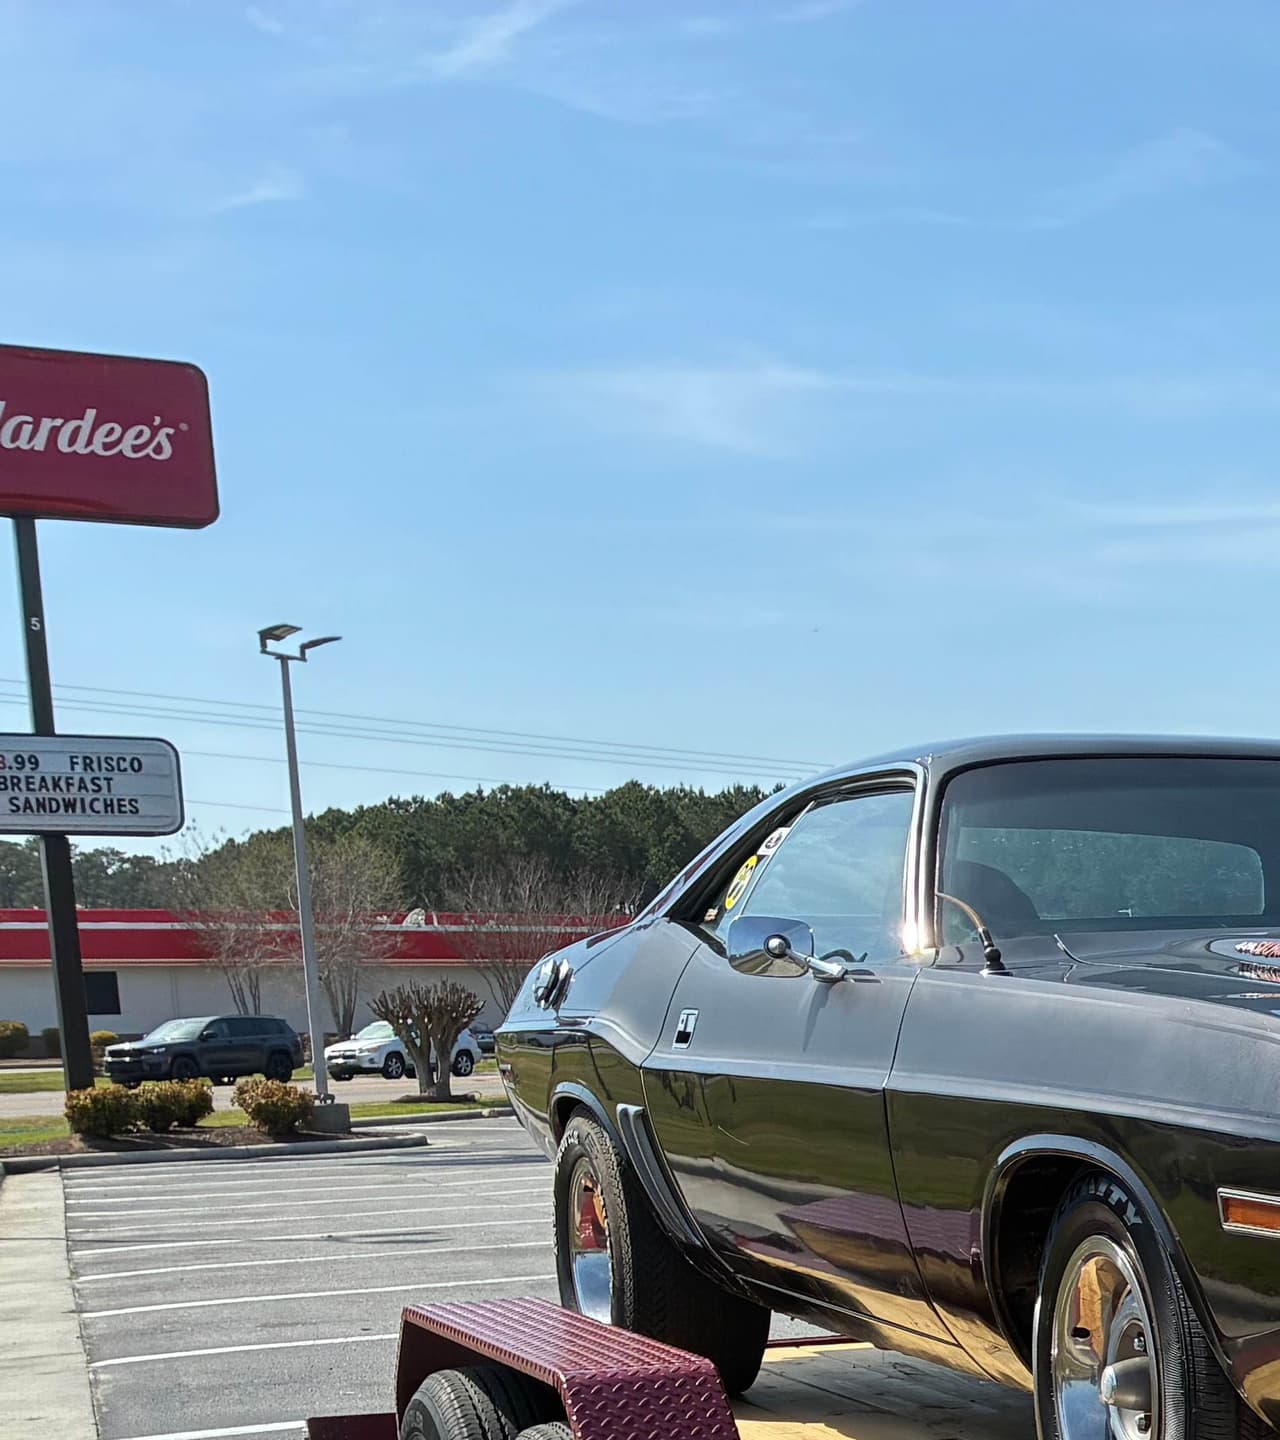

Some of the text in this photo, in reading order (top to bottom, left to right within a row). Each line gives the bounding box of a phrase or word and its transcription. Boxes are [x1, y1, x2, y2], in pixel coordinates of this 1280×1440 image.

[0, 401, 176, 460] ardee's
[30, 617, 41, 631] 5
[69, 755, 143, 773] FRISCO
[0, 776, 114, 793] BREAKFAST
[9, 796, 140, 815] SANDWICHES
